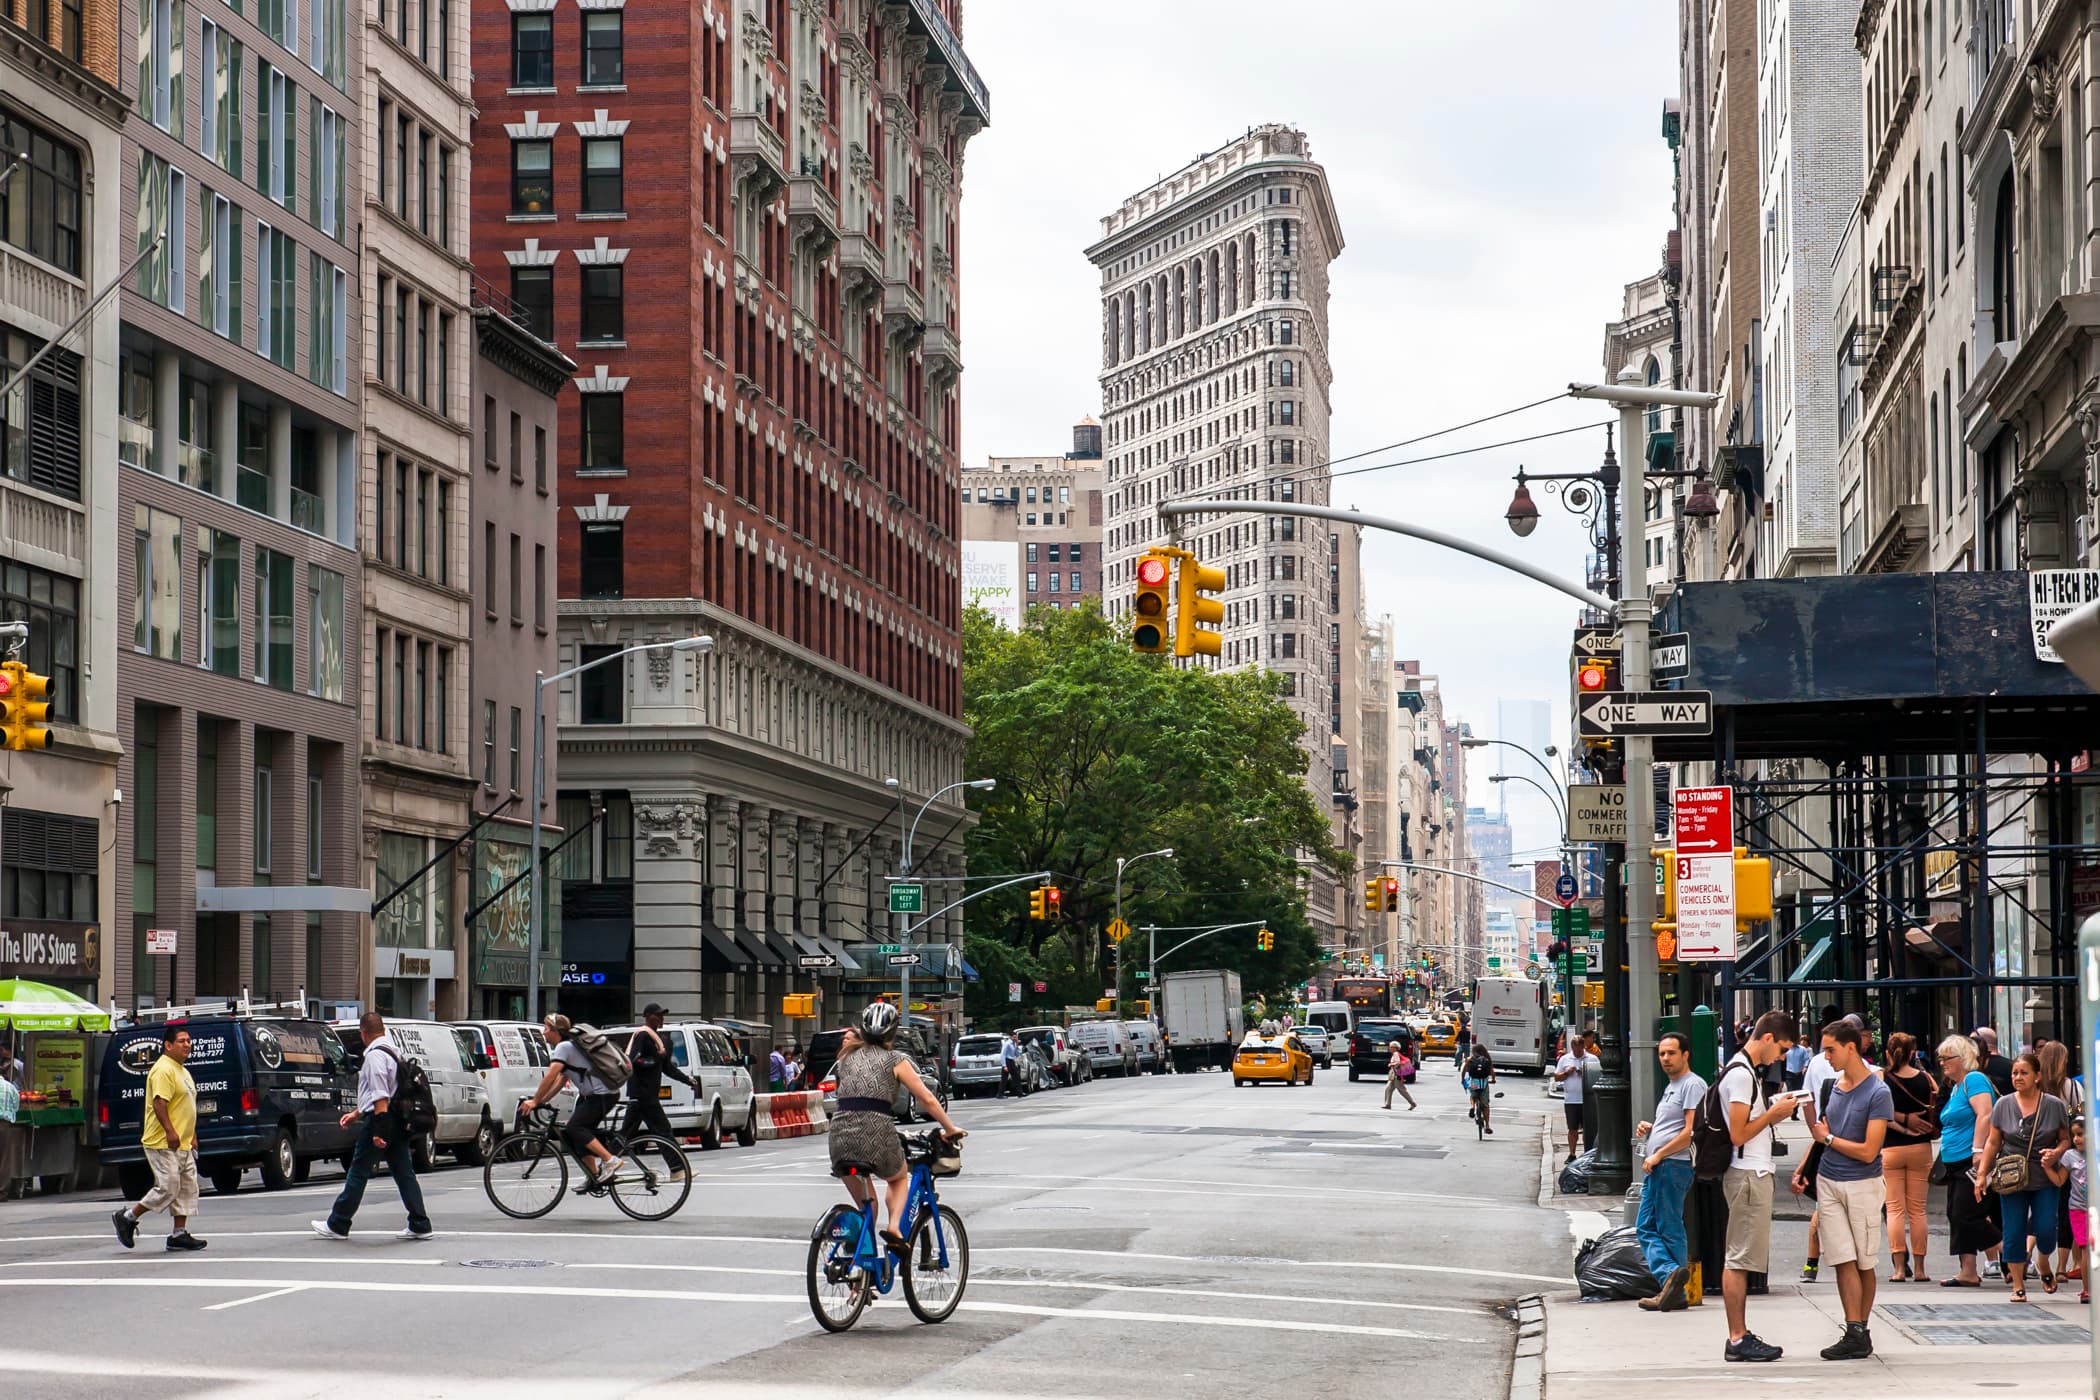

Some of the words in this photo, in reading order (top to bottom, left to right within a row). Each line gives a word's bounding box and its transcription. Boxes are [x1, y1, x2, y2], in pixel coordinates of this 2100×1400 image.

[969, 587, 1012, 597] HAPPY
[2034, 572, 2080, 604] HI-TECH
[2035, 608, 2048, 617] 184
[1586, 637, 1611, 649] ONE
[1661, 648, 1683, 666] WAY
[1598, 706, 1636, 722] ONE
[1661, 705, 1700, 721] WAY
[1599, 792, 1624, 805] NO
[1677, 792, 1688, 802] NO
[1688, 791, 1723, 802] STANDING
[1677, 807, 1697, 815] Monday
[1702, 806, 1718, 815] Friday
[1679, 860, 1689, 879] 3
[1680, 884, 1723, 894] COMMERCIAL
[1680, 895, 1711, 904] VEHICLES
[1712, 895, 1730, 904] ONLY
[1591, 931, 1599, 939] 27
[0, 931, 20, 963] The
[23, 932, 46, 964] UPS
[48, 934, 77, 965] Store
[196, 1081, 228, 1092] SERVICE
[121, 1089, 132, 1099] 24
[134, 1088, 144, 1097] HR
